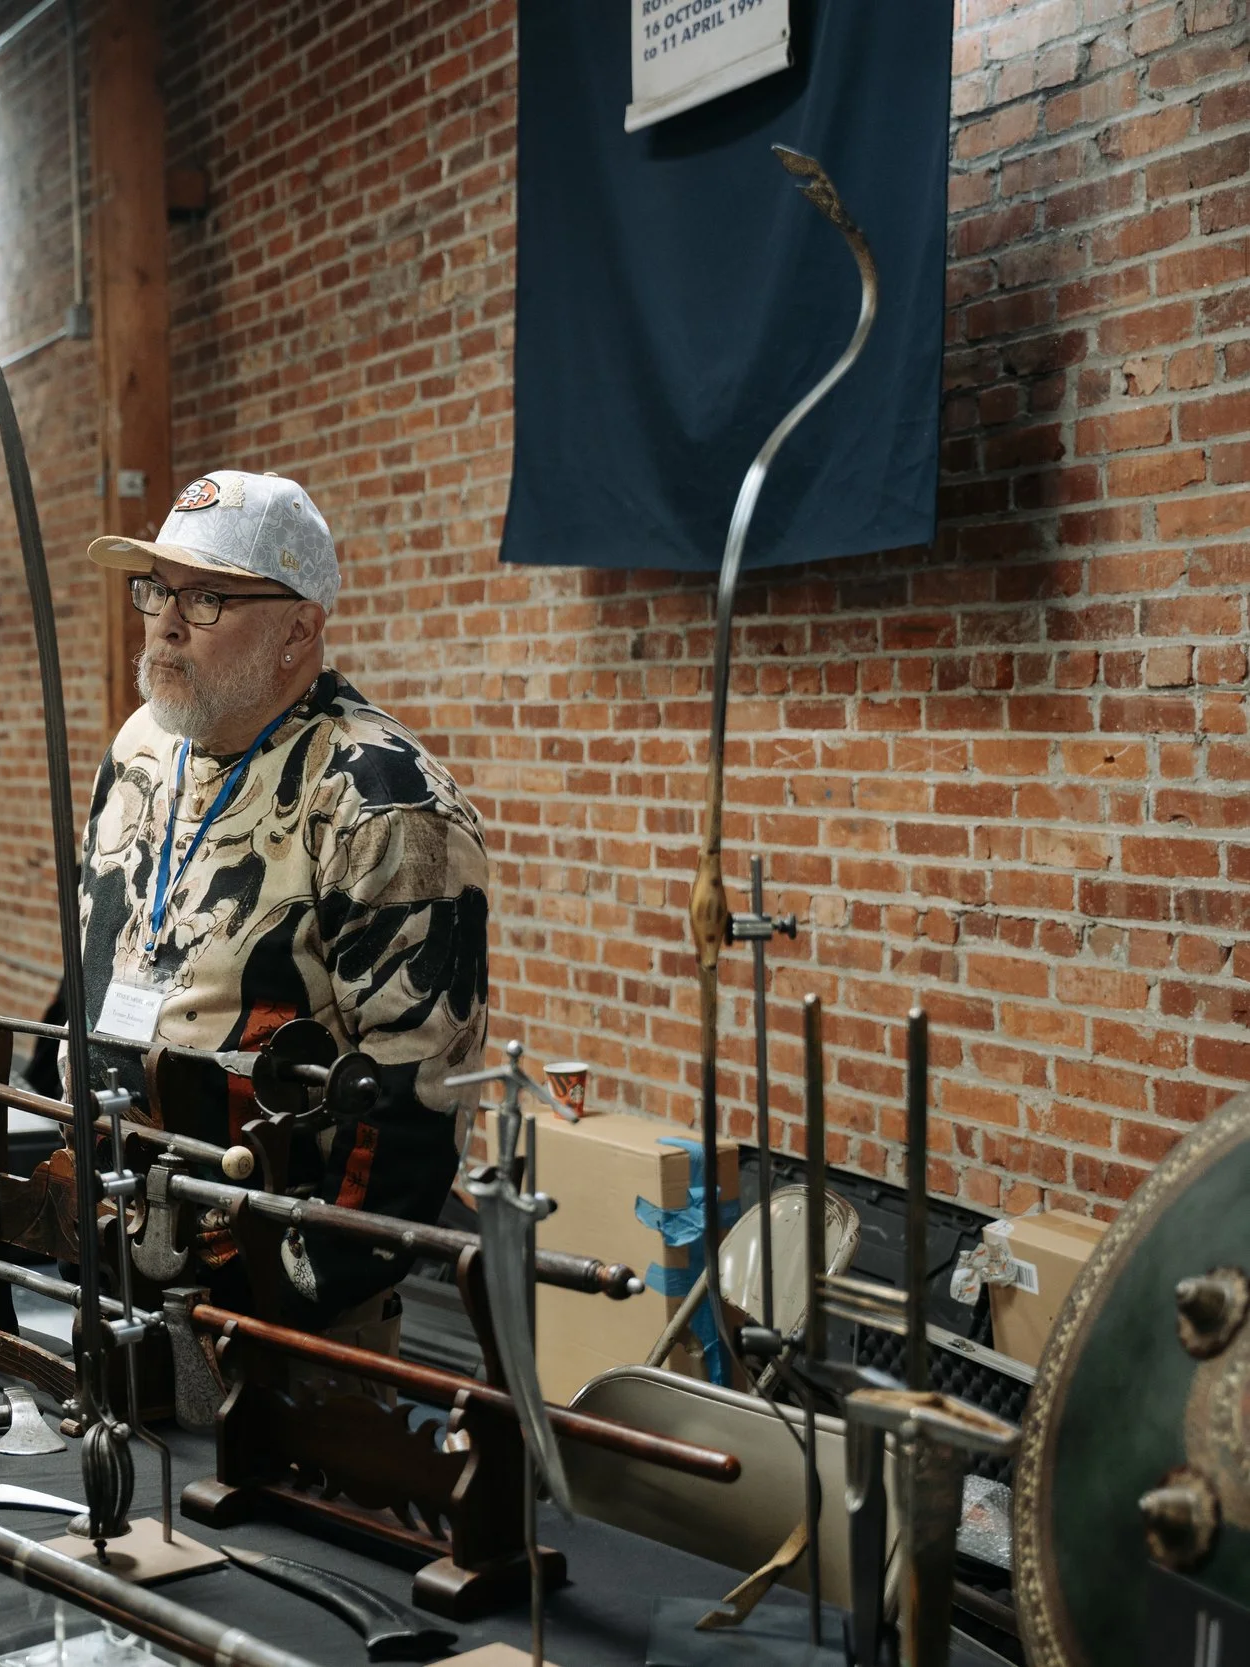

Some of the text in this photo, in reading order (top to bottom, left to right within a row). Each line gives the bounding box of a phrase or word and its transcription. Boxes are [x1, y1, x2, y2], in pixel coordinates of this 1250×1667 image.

[643, 47, 658, 61] to
[661, 33, 676, 53] 11
[681, 10, 725, 44] APRIL
[644, 20, 661, 39] 16
